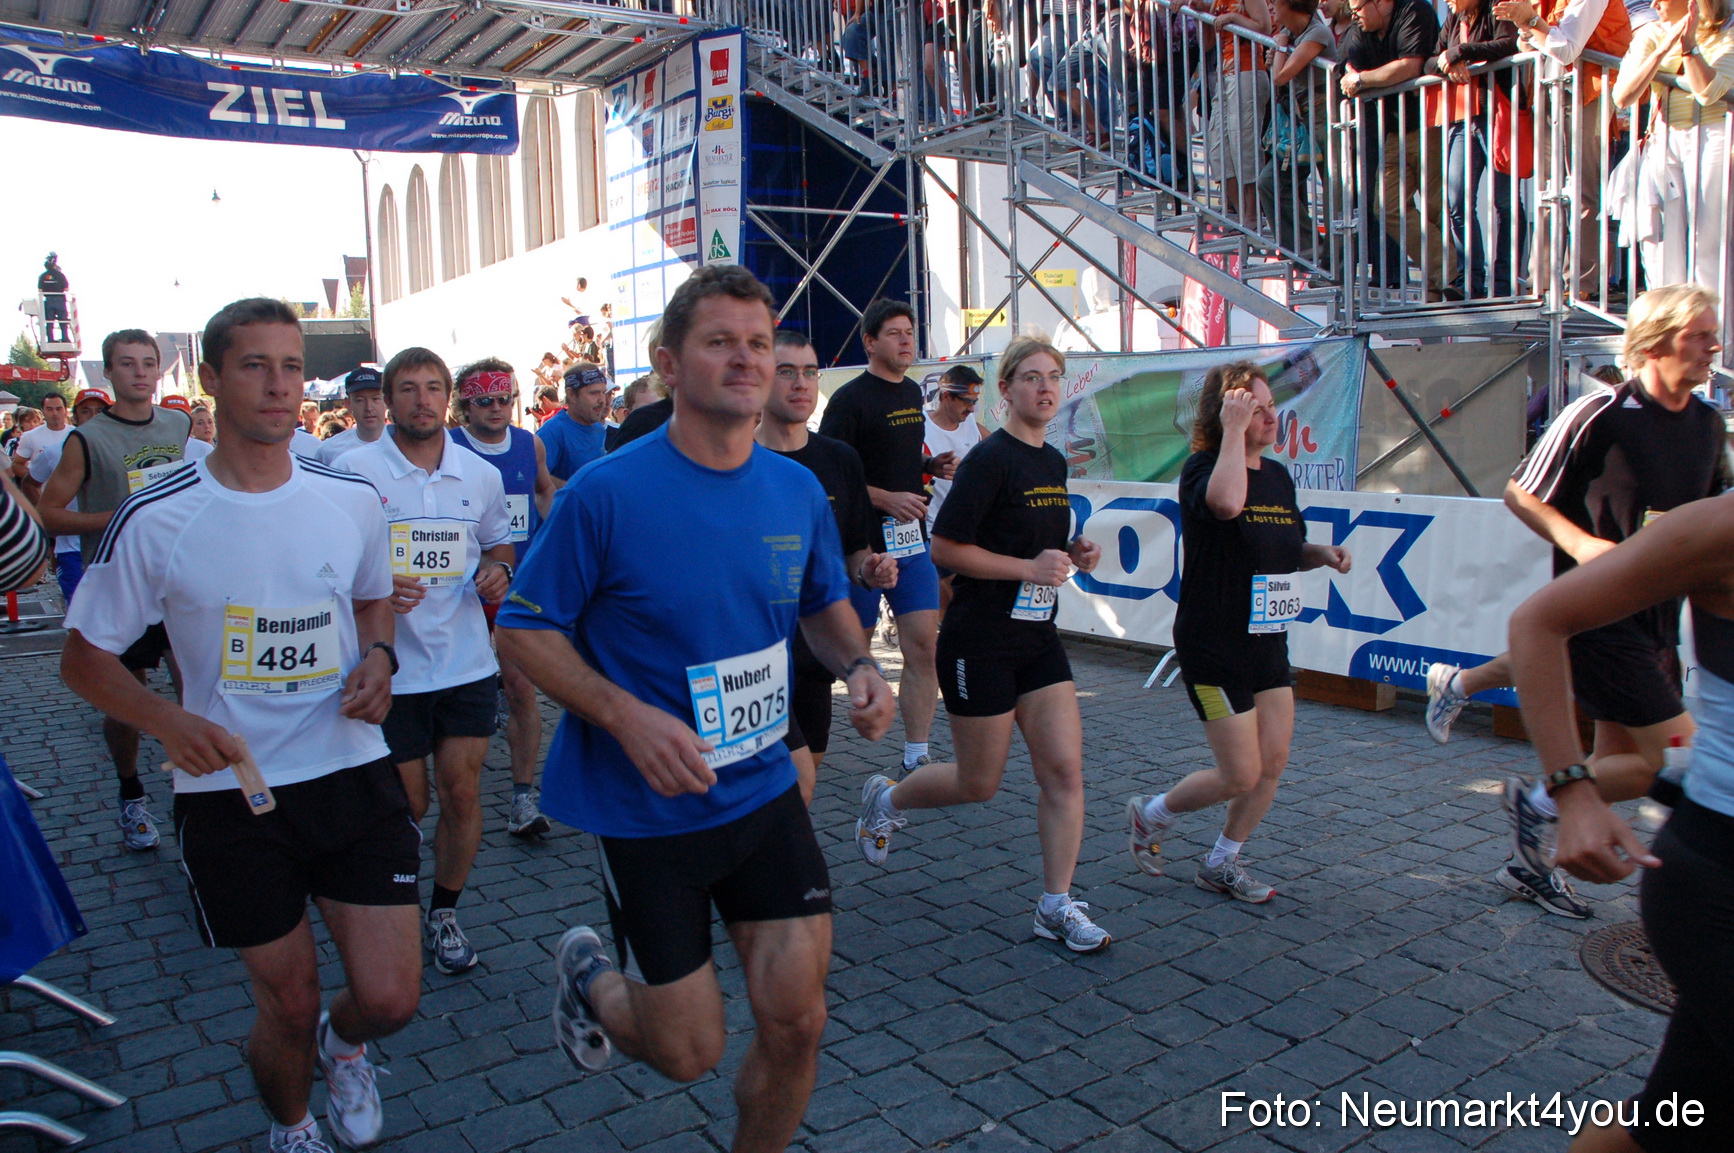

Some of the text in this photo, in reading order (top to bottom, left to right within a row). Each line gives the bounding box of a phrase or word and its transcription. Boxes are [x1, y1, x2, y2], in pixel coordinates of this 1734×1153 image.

[207, 81, 346, 131] ZIEL
[1066, 362, 1098, 399] Leben
[411, 530, 459, 542] Christian
[886, 531, 892, 539] B
[897, 528, 920, 545] 3062
[396, 547, 405, 557] B
[412, 551, 450, 569] 485
[1023, 582, 1031, 592] C
[1268, 581, 1290, 592] Silvia
[1255, 597, 1262, 606] C
[1268, 597, 1300, 617] 3063
[257, 611, 332, 634] Benjamin
[231, 638, 244, 653] B
[257, 642, 318, 671] 484
[722, 664, 771, 693] Hubert
[704, 707, 717, 723] C
[730, 686, 785, 736] 2075
[393, 874, 417, 883] JAKO
